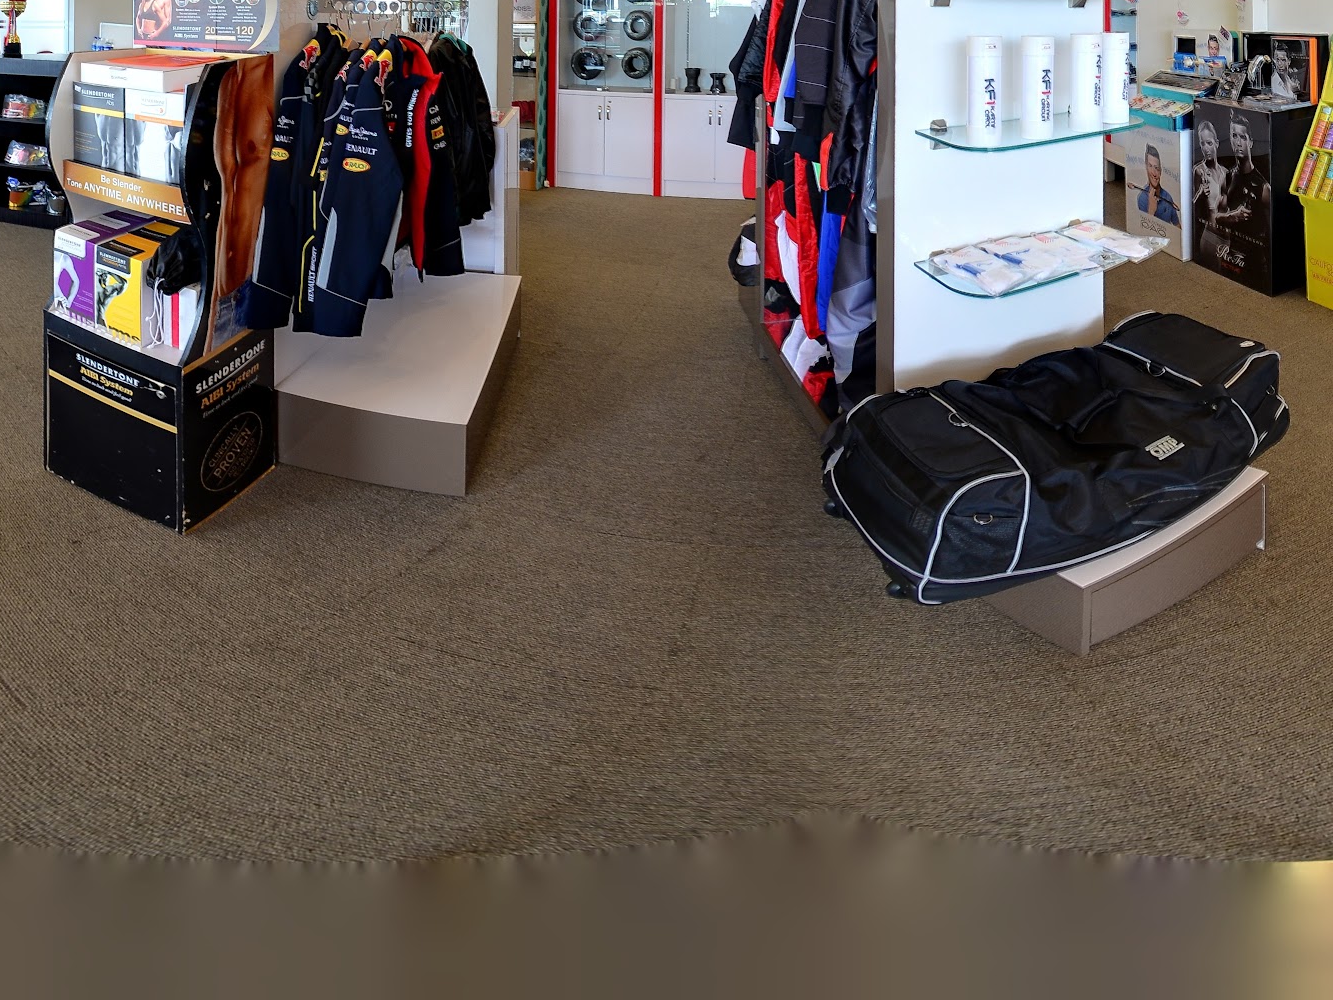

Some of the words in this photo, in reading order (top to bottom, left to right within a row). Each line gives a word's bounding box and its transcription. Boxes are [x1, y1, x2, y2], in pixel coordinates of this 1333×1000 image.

[236, 26, 254, 35] 120
[81, 89, 114, 98] SLENDERTONE
[984, 78, 996, 105] KF1
[1041, 69, 1052, 95] KF1
[408, 88, 419, 111] WINGS
[67, 177, 82, 189] Tone
[84, 182, 124, 202] ANYTIME,
[127, 195, 186, 216] ANYWHERE!
[100, 174, 110, 184] Be
[112, 178, 143, 193] Slender.
[308, 270, 316, 302] RENAULT
[76, 353, 140, 387] SLENDERTONE
[195, 339, 266, 394] SLENDERTONE
[100, 375, 133, 397] System
[201, 388, 224, 409] AIBI
[226, 363, 259, 392] System
[208, 425, 239, 468] CLINICALLY
[213, 427, 252, 479] PROVEN
[1149, 437, 1179, 458] OMP
